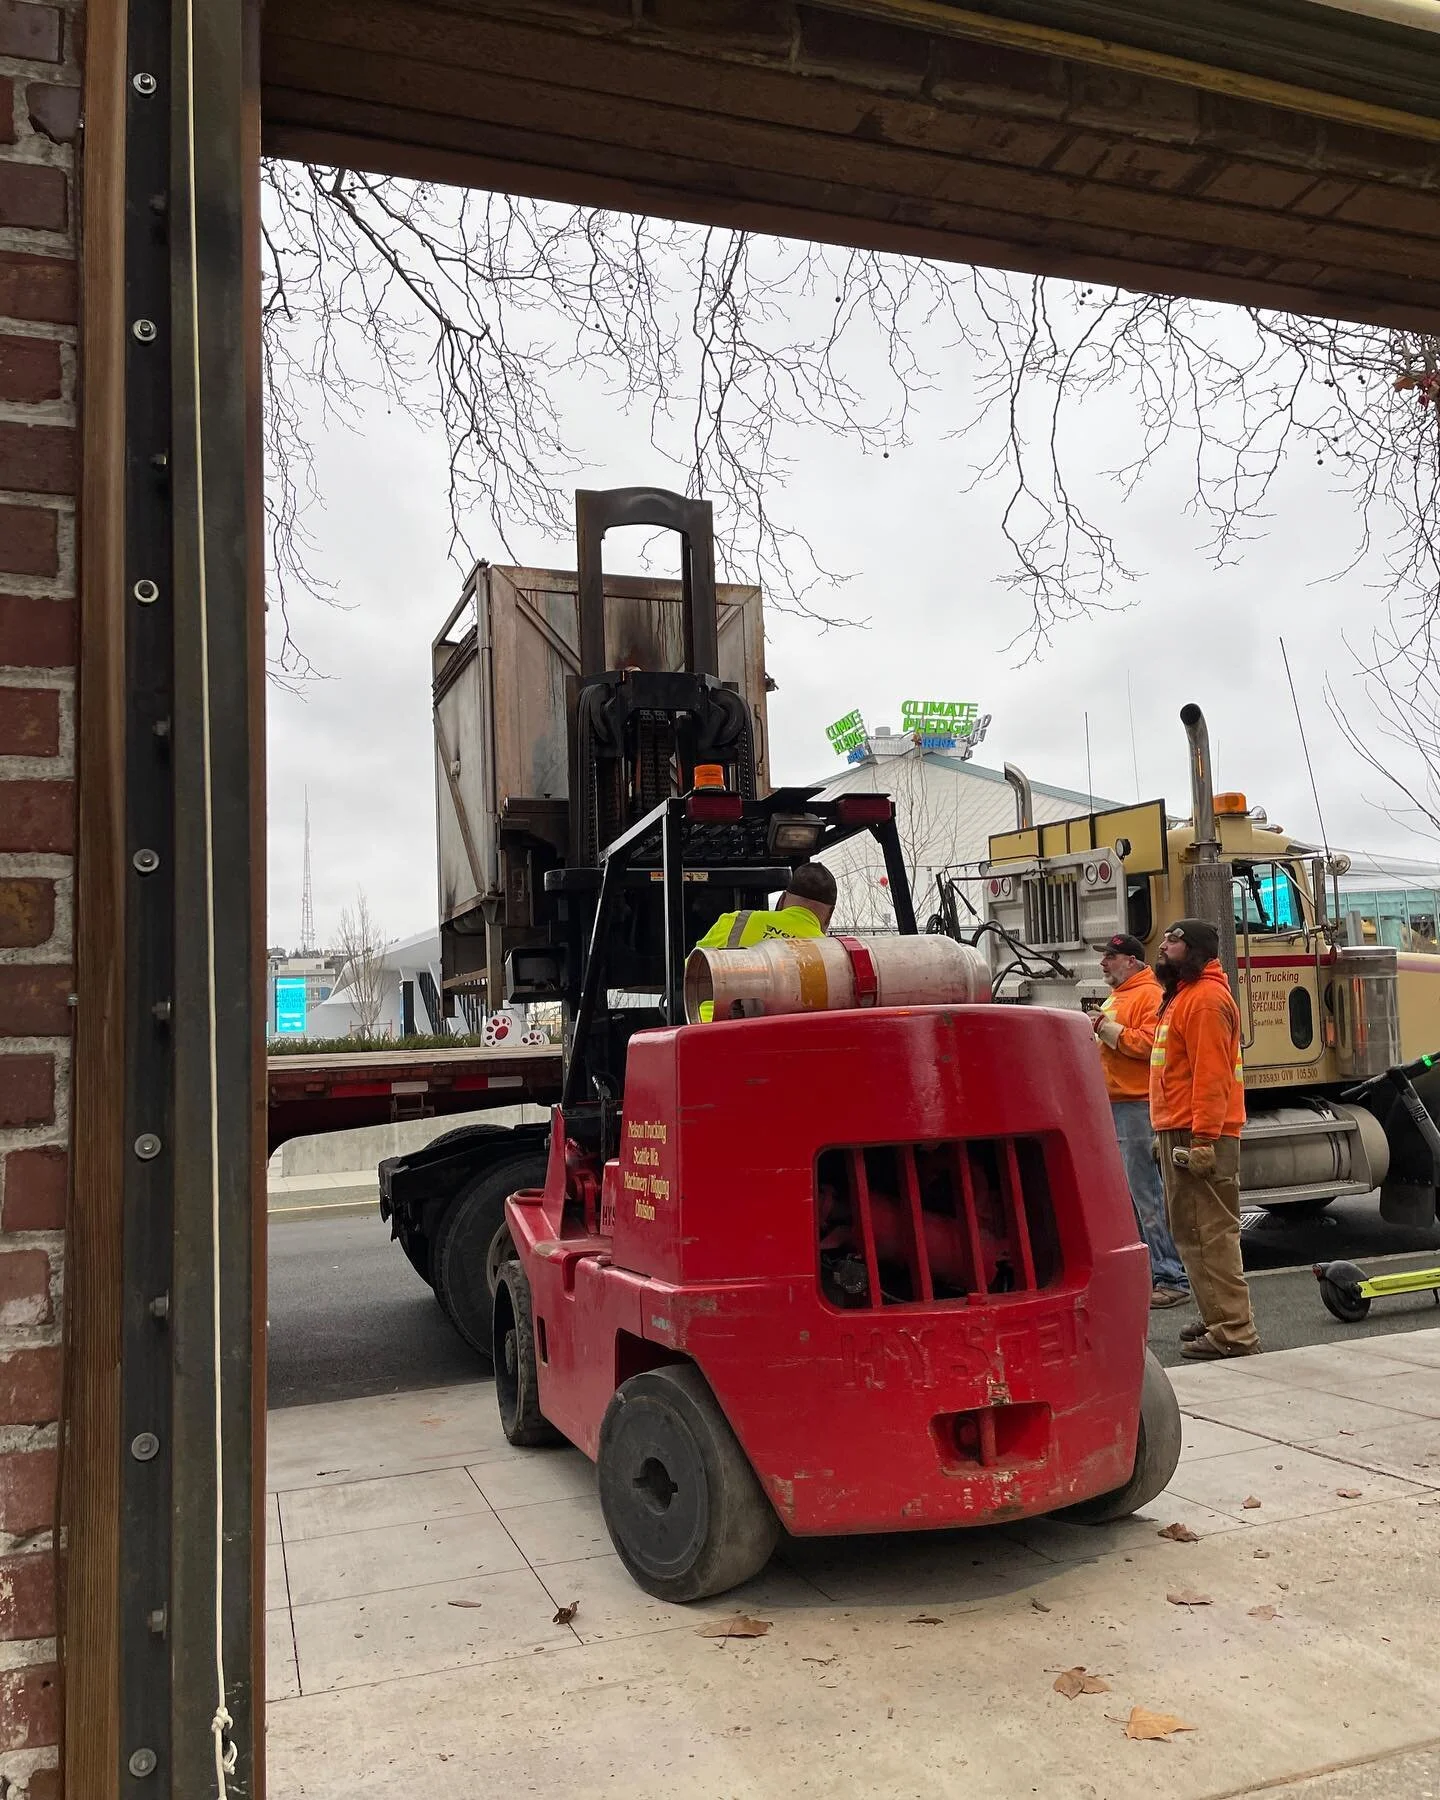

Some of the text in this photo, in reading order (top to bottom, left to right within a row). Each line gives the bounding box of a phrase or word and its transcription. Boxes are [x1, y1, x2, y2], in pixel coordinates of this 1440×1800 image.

[901, 699, 979, 718] CLIMATE
[825, 708, 863, 741] CLIMATE
[832, 726, 867, 755] PLEDGE
[1238, 971, 1299, 984] elon Trucking
[1251, 990, 1286, 1002] HEAVY HAUL
[1252, 1001, 1286, 1012] SPECIALIST
[1253, 1019, 1274, 1027] Seattle
[627, 1120, 667, 1144] Nelson Trucking
[633, 1146, 650, 1166] Seattle
[650, 1174, 670, 1201] Rigging
[635, 1199, 656, 1221] Division
